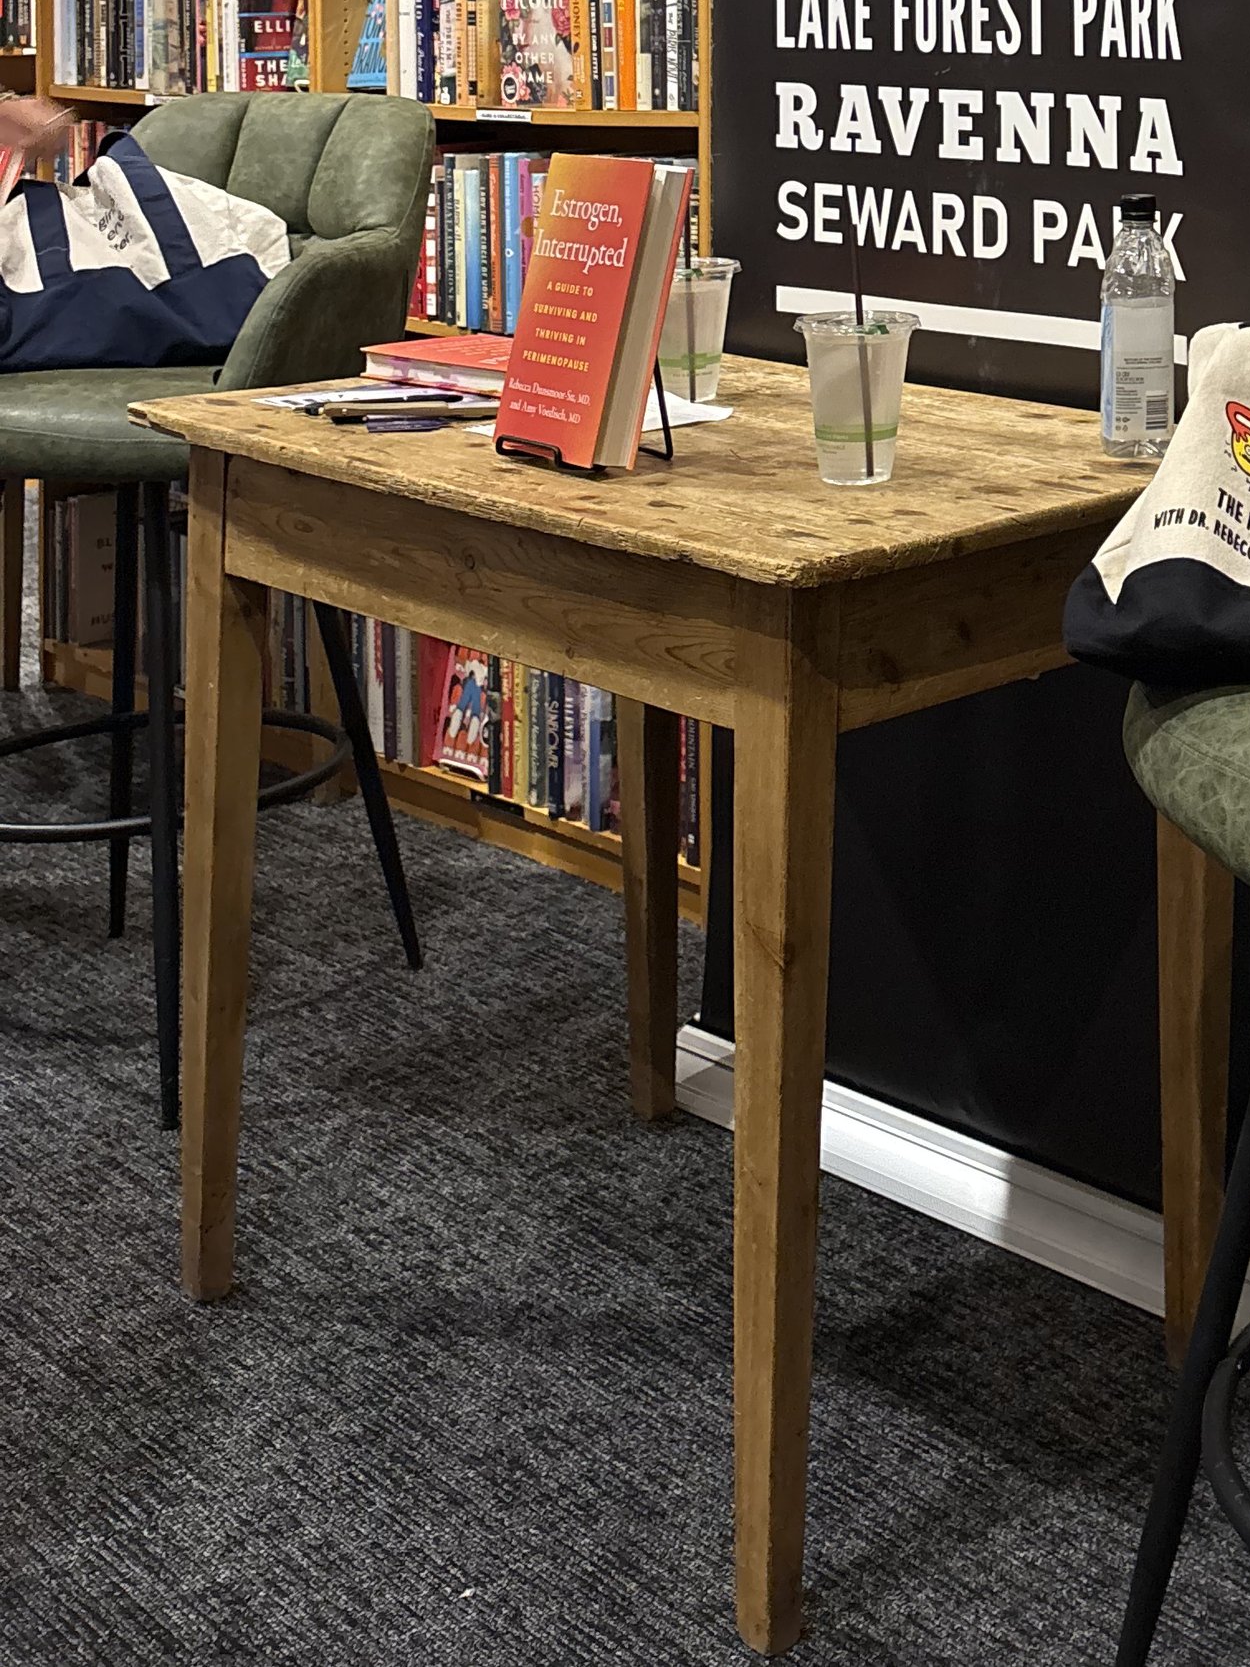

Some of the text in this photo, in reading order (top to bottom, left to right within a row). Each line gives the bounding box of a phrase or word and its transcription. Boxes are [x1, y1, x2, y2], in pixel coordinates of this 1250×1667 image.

[515, 51, 555, 65] OTHER
[518, 71, 553, 84] NAME
[775, 82, 1184, 176] RAVENNA
[550, 189, 623, 232] Estrogen,
[776, 180, 1186, 282] SEWARD PAK
[533, 228, 628, 275] Interrupted
[547, 281, 594, 297] A GUIDE TO
[534, 302, 598, 322] SURVIVING AND
[535, 328, 586, 345] THRIVING IN
[522, 350, 590, 372] PERIMENOPAUSE
[509, 400, 521, 411] and
[521, 402, 538, 417] Amy
[1217, 488, 1244, 523] THE
[1153, 507, 1183, 530] WITH
[1188, 509, 1210, 531] DR.
